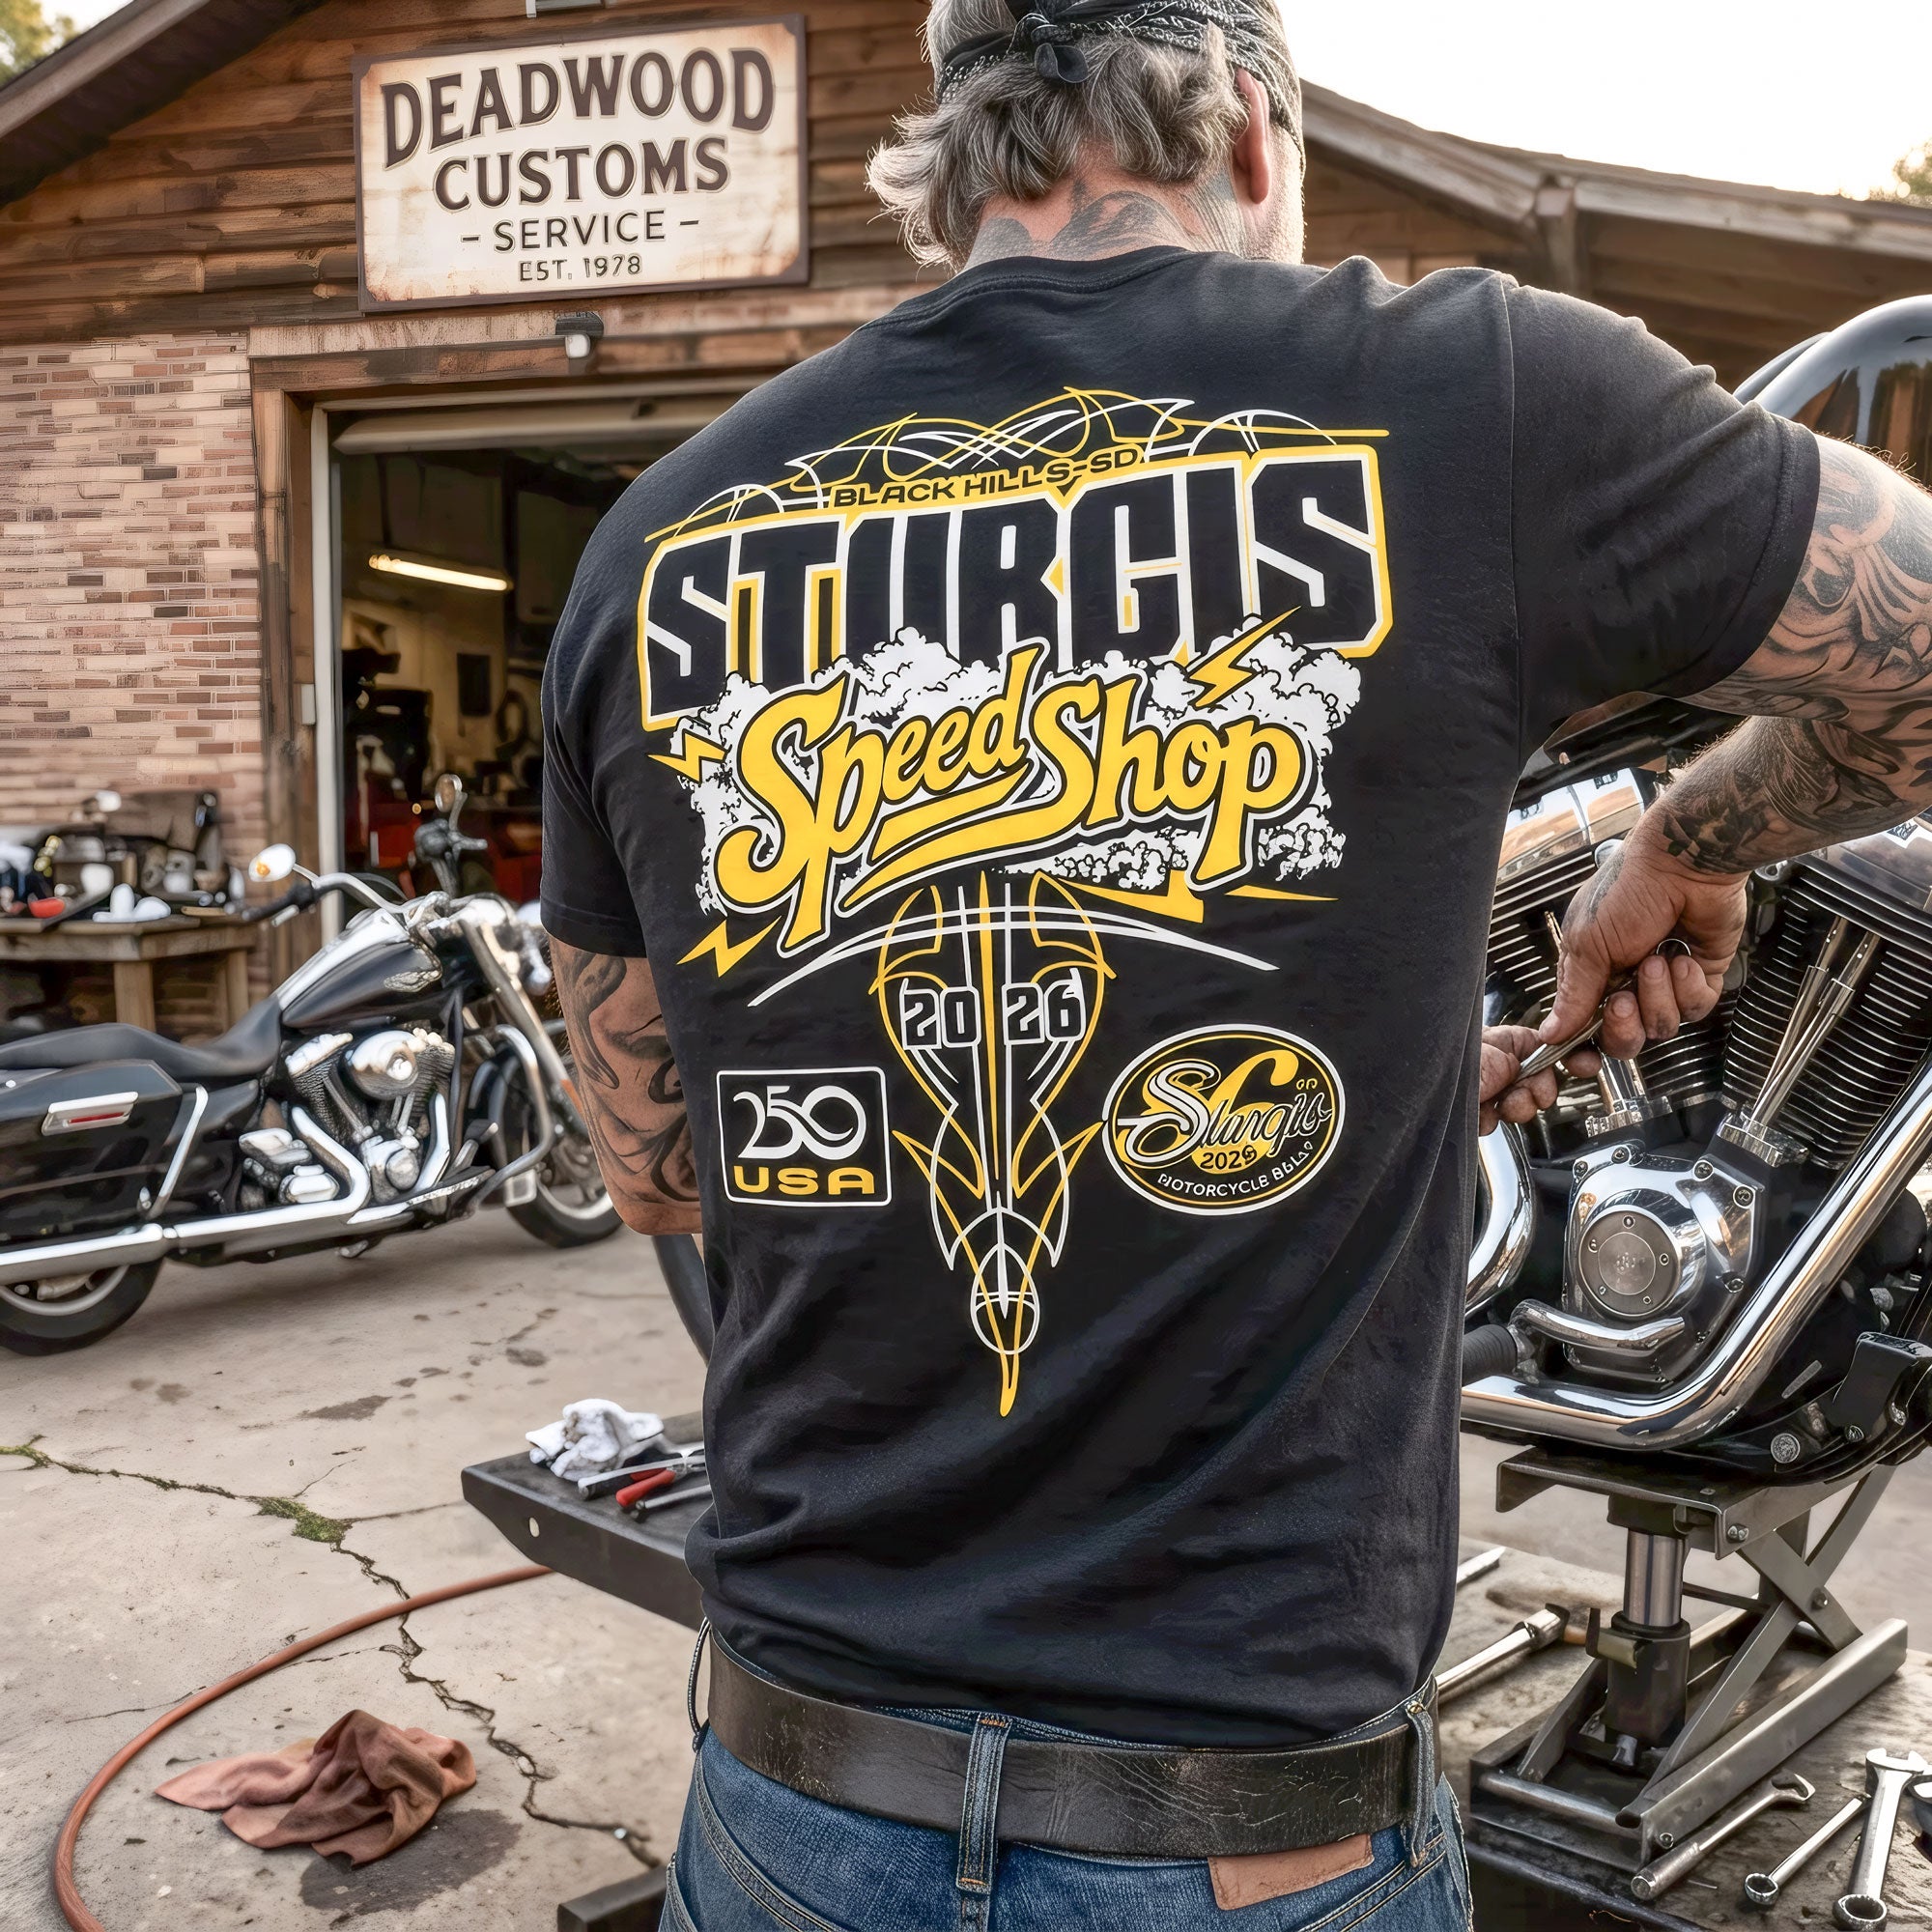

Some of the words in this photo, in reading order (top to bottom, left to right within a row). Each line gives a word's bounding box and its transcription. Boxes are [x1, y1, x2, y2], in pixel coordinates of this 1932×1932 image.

[380, 48, 775, 169] DEADWOOD
[434, 137, 730, 211] CUSTOMS
[493, 210, 666, 251] SERVICE
[519, 259, 573, 282] EST.
[582, 255, 642, 278] 1978
[834, 480, 954, 508] BLACK
[643, 450, 1383, 724] STURGIS
[732, 1085, 867, 1160] 250
[732, 1165, 875, 1195] USA
